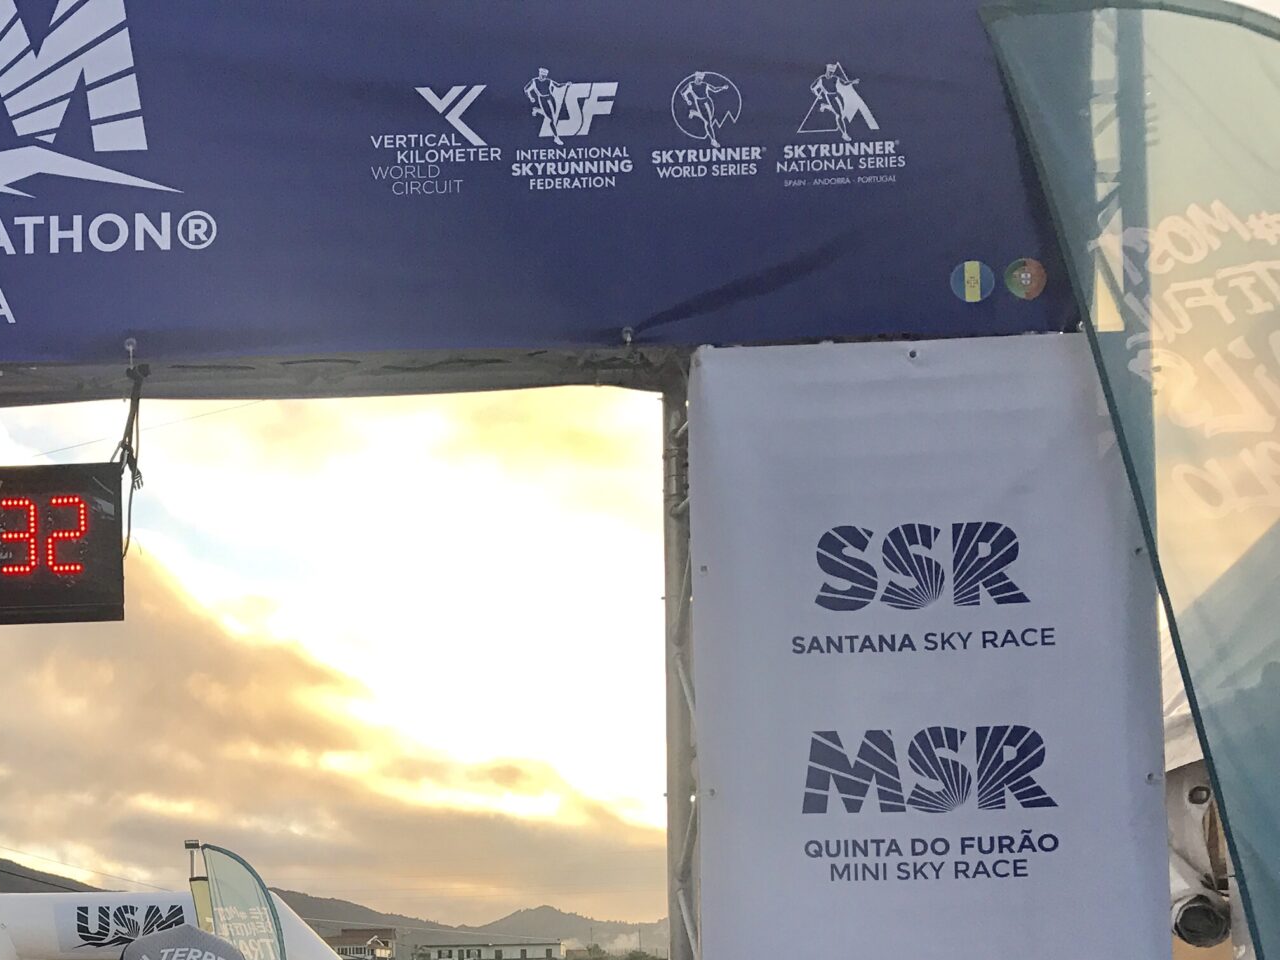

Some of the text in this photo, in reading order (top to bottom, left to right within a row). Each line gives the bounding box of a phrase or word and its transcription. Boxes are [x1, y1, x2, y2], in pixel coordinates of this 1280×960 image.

[370, 133, 461, 148] VERTICAL
[397, 148, 501, 164] KILOMETER
[516, 147, 630, 161] INTERNATIONAL
[511, 160, 633, 176] SKYRUNNING
[657, 164, 757, 178] WORLD SERIES
[776, 155, 905, 173] NATIONAL SERIES
[371, 165, 440, 180] WORLD
[392, 180, 463, 195] CIRCUIT
[530, 176, 616, 190] FEDERATION
[814, 521, 1031, 612] SSR
[791, 627, 1056, 655] SANTANA SKY RACE
[802, 725, 1059, 814] MSR
[804, 830, 1059, 859] QUINTA DO FURÃO
[830, 859, 1029, 882] MINI SKY RACE
[76, 904, 185, 942] USM
